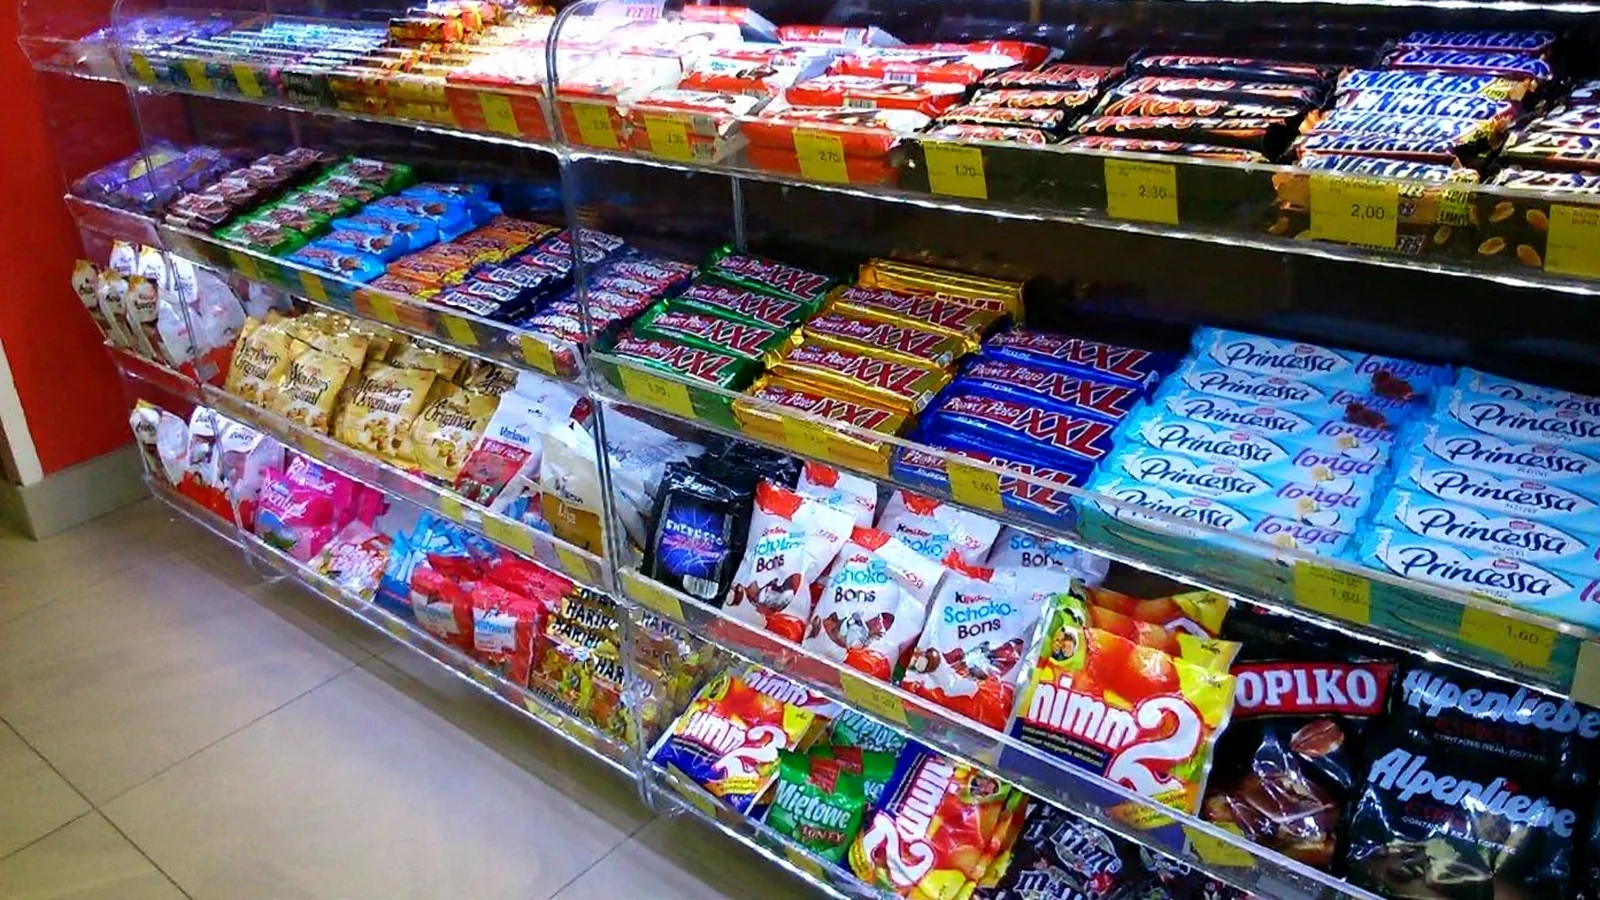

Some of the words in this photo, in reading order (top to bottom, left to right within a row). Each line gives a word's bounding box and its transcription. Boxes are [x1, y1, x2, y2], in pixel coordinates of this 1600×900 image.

[1342, 69, 1490, 94] SNICKERS
[1402, 50, 1550, 78] SNICKERS
[1350, 203, 1386, 221] 2,00
[762, 263, 830, 301] XXL
[735, 291, 802, 329] XXL
[899, 296, 980, 334] XXL
[703, 319, 776, 360] XXL
[864, 323, 947, 362] XXL
[1226, 341, 1336, 373] Princessa
[660, 345, 737, 386] XXL
[842, 356, 930, 399] XXL
[1052, 338, 1152, 381] XXL
[1036, 372, 1137, 418] XXL
[1199, 370, 1311, 404] Princessa
[1010, 407, 1114, 459] XXL
[1183, 398, 1299, 434] Princessa
[1158, 424, 1273, 463] Princessa
[1292, 448, 1376, 476] longa
[1445, 437, 1588, 475] Princessa
[1140, 456, 1256, 495] Princessa
[1275, 481, 1362, 510] longa
[1431, 470, 1578, 513] Princessa
[1253, 512, 1341, 546] longa
[1418, 507, 1568, 556] Princessa
[1398, 547, 1553, 597] Princessa
[834, 585, 876, 604] Bons
[957, 617, 1002, 641] Bons
[1235, 665, 1378, 708] OPIKO
[775, 779, 852, 829] Miętowe
